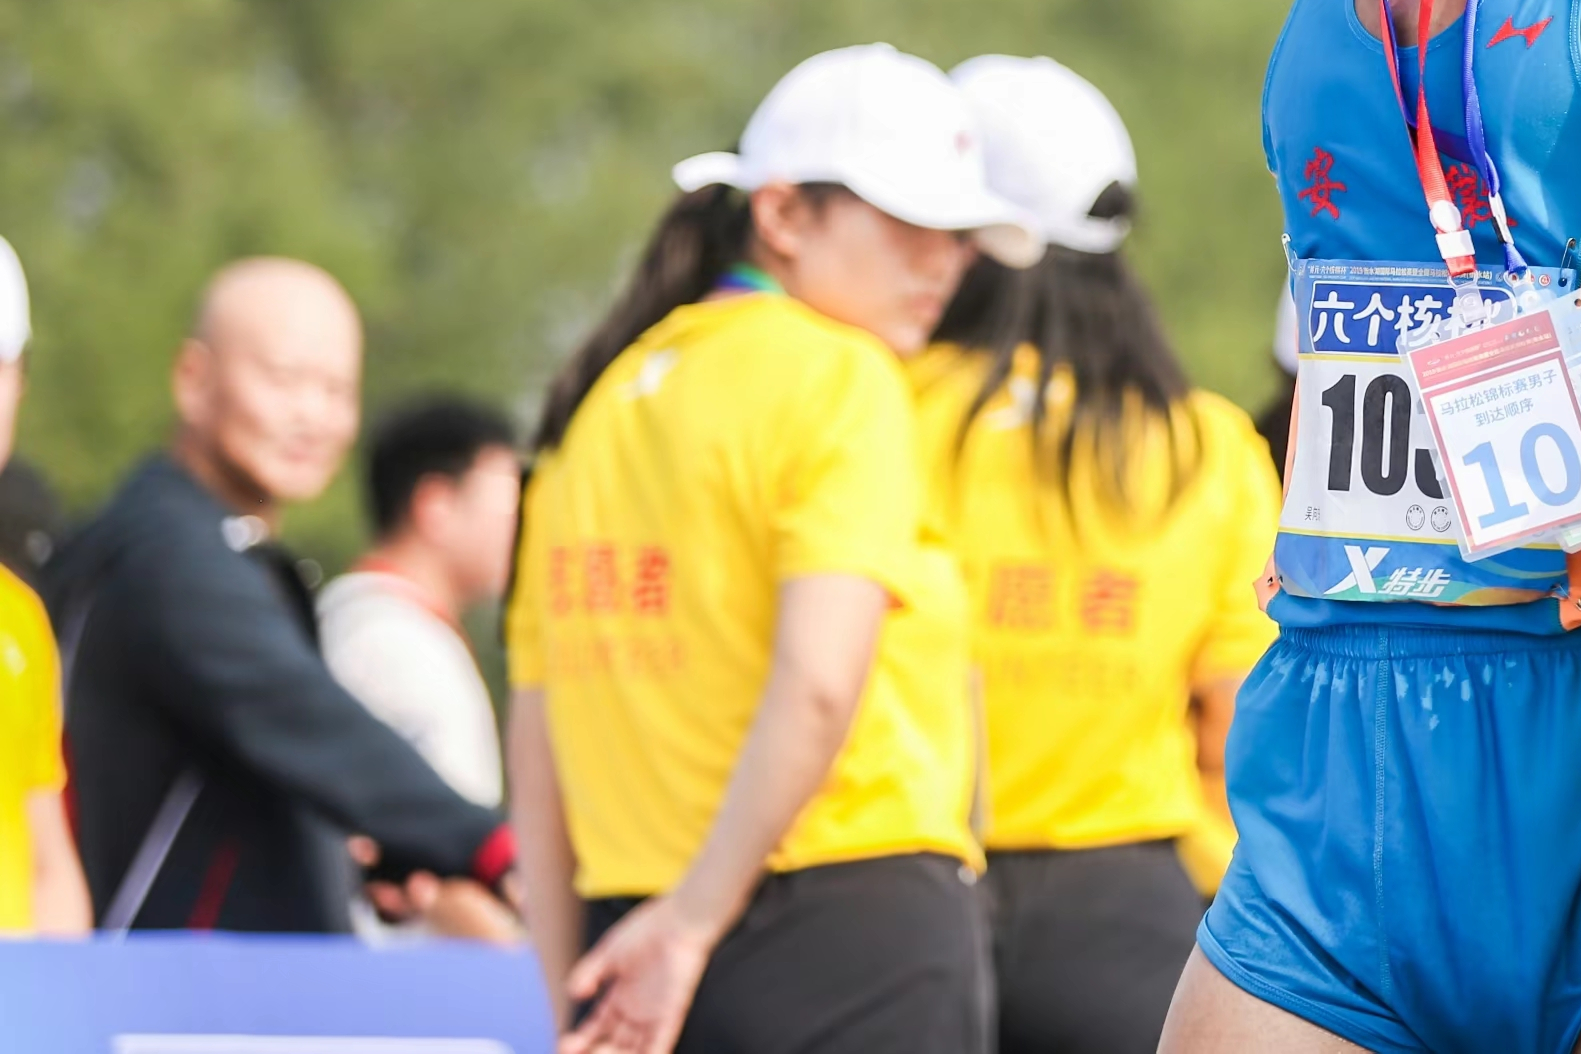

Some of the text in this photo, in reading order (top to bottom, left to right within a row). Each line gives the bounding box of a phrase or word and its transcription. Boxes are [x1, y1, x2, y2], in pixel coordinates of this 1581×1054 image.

[1440, 369, 1557, 416] 马拉松锦标赛男子
[1474, 397, 1534, 427] 到达顺序
[1462, 422, 1581, 529] 10
